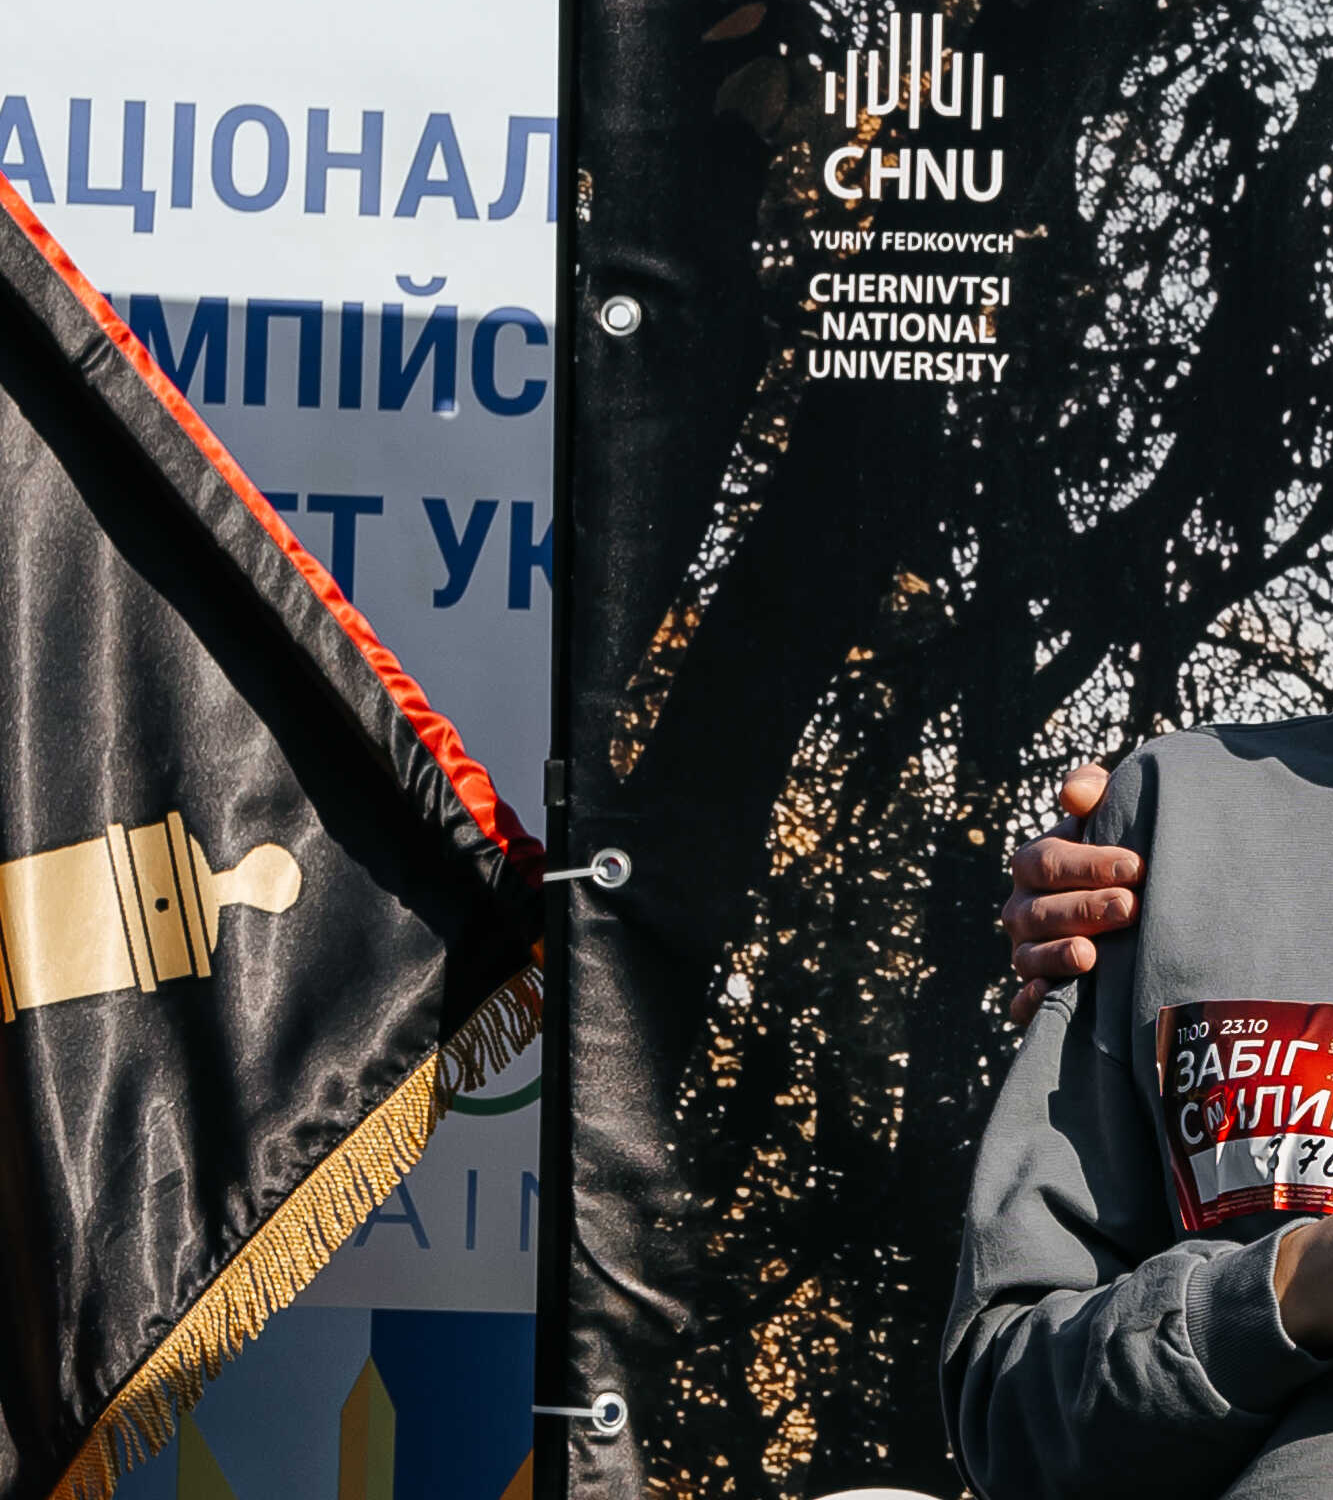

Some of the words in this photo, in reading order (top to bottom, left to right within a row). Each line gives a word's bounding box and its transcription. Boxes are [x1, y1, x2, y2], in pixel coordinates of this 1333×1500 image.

[824, 147, 1004, 203] CHNU
[811, 230, 876, 252] YURIY
[881, 233, 1014, 255] FEDKOVYCH
[809, 272, 1010, 307] CHERNIVTSI
[822, 312, 997, 344] NATIONAL
[101, 275, 549, 417] МПІЙС
[808, 350, 1010, 383] UNIVERSITY
[1219, 1018, 1269, 1036] 23.10
[1176, 1039, 1320, 1094] ЗАБІГ
